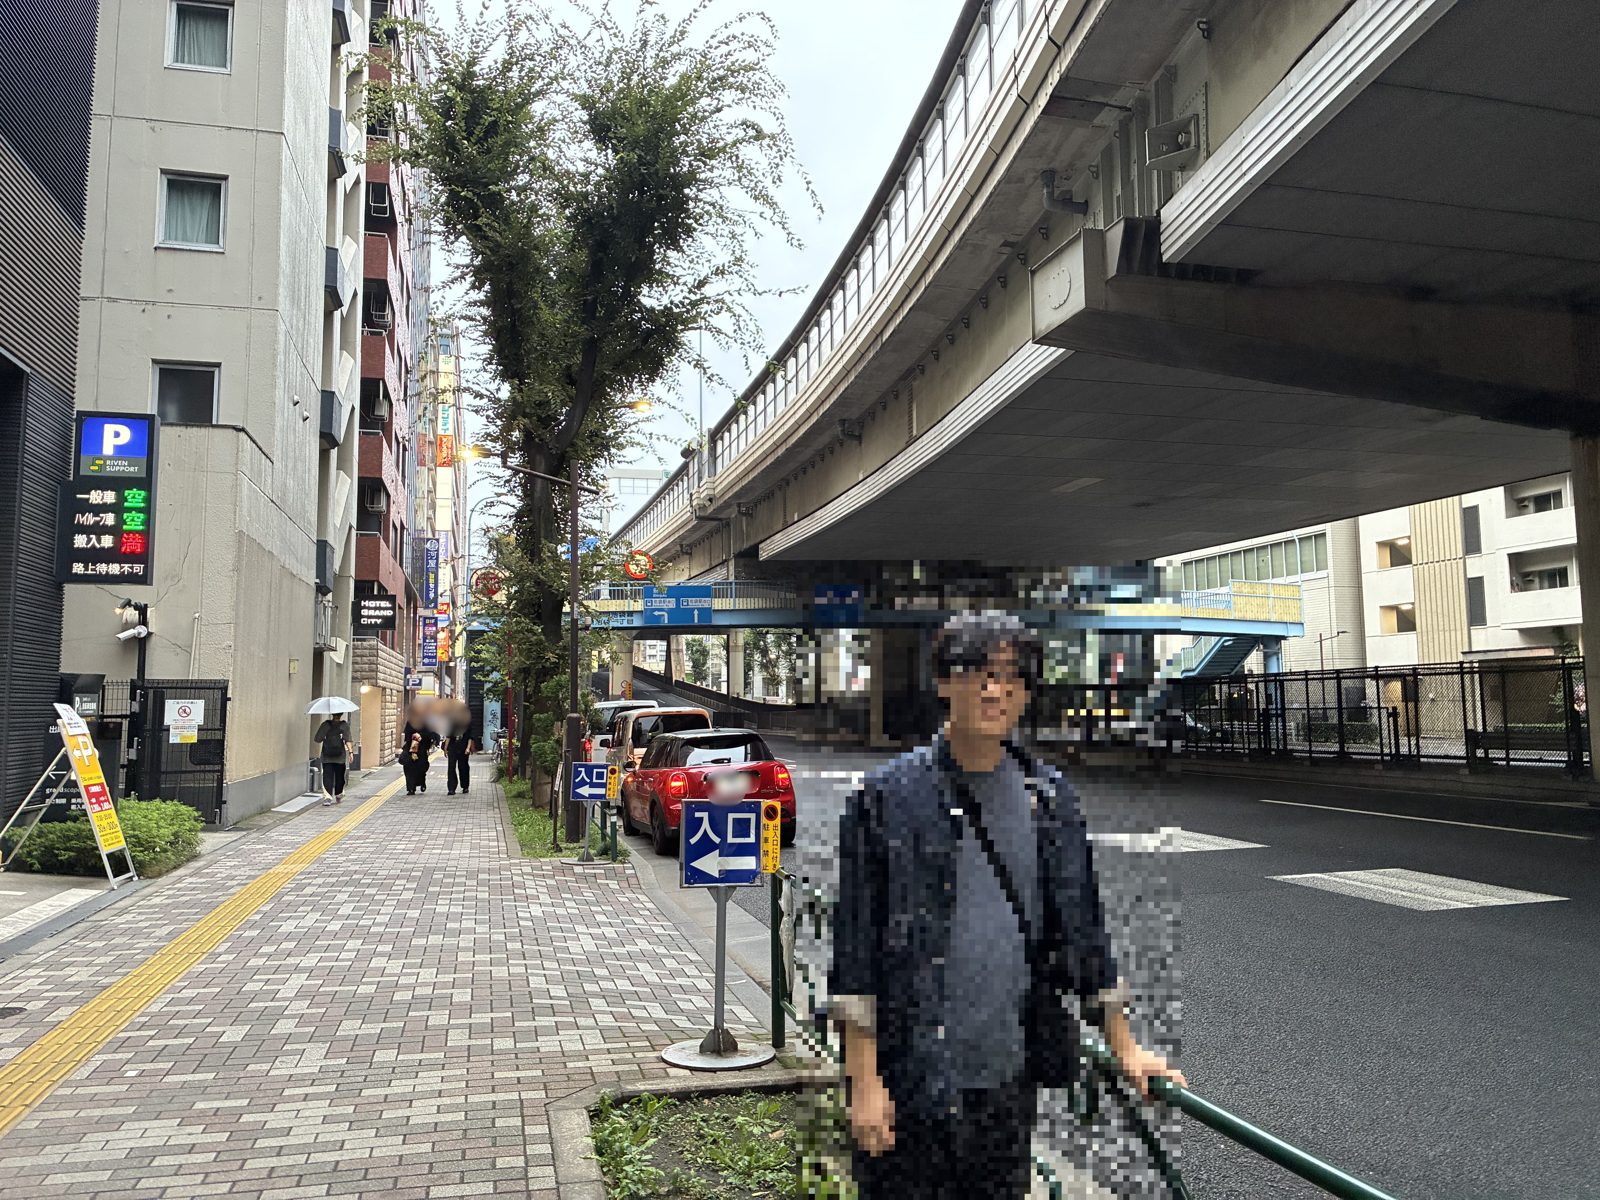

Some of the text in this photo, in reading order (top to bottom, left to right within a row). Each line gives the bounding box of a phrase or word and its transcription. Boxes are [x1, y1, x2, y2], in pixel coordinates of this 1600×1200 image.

[102, 423, 131, 456] P
[76, 488, 146, 507] 一般車 空
[74, 510, 145, 530] ハイルーフ車 空
[73, 533, 144, 554] 搬入車 満
[72, 563, 145, 575] 路上待機不可
[361, 600, 392, 608] HOTEL
[360, 617, 382, 625] CITY
[575, 768, 607, 783] 入口
[689, 811, 757, 845] 入口
